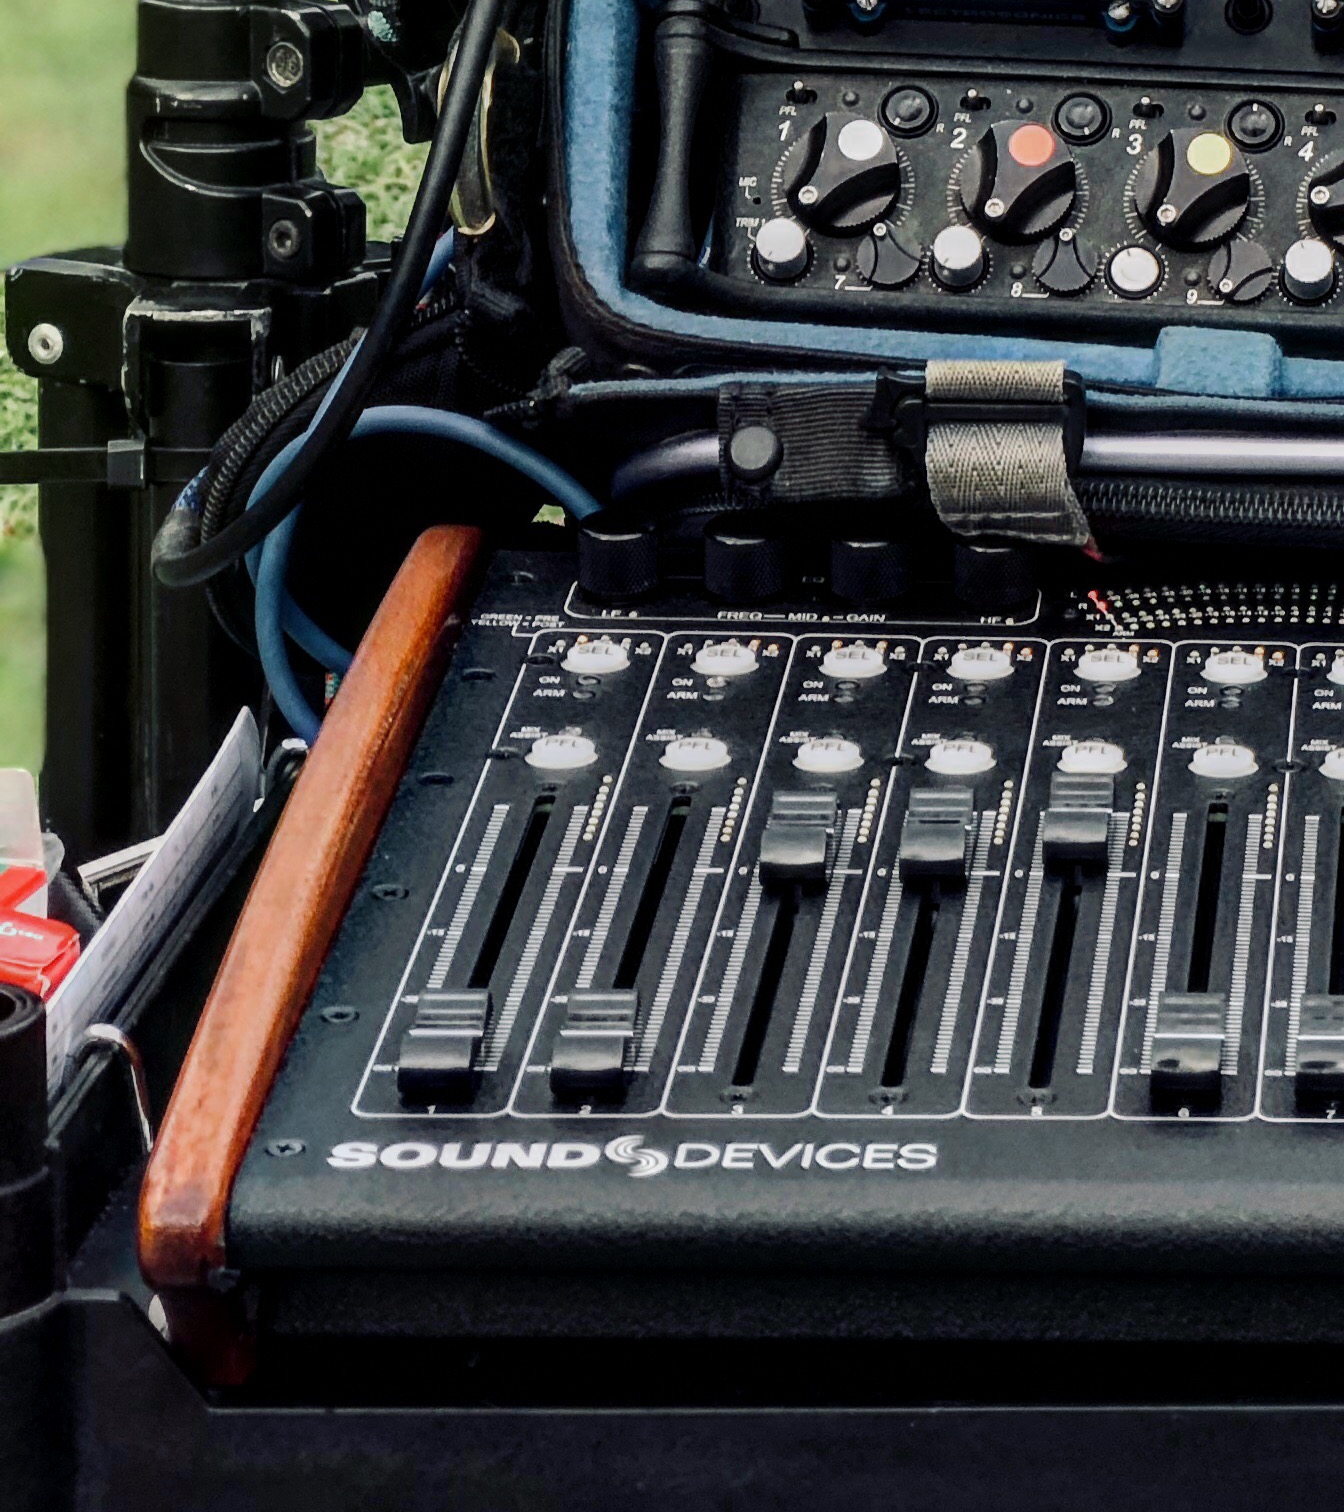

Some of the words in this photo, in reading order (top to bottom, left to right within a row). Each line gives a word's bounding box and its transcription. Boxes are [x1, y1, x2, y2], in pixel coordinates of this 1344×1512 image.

[950, 128, 967, 149] 2
[1298, 142, 1315, 163] 4
[717, 611, 764, 622] FREQ
[787, 612, 817, 623] MID
[846, 612, 886, 624] GAIN
[326, 1141, 600, 1171] SOUND
[673, 1142, 939, 1171] DEVICES
